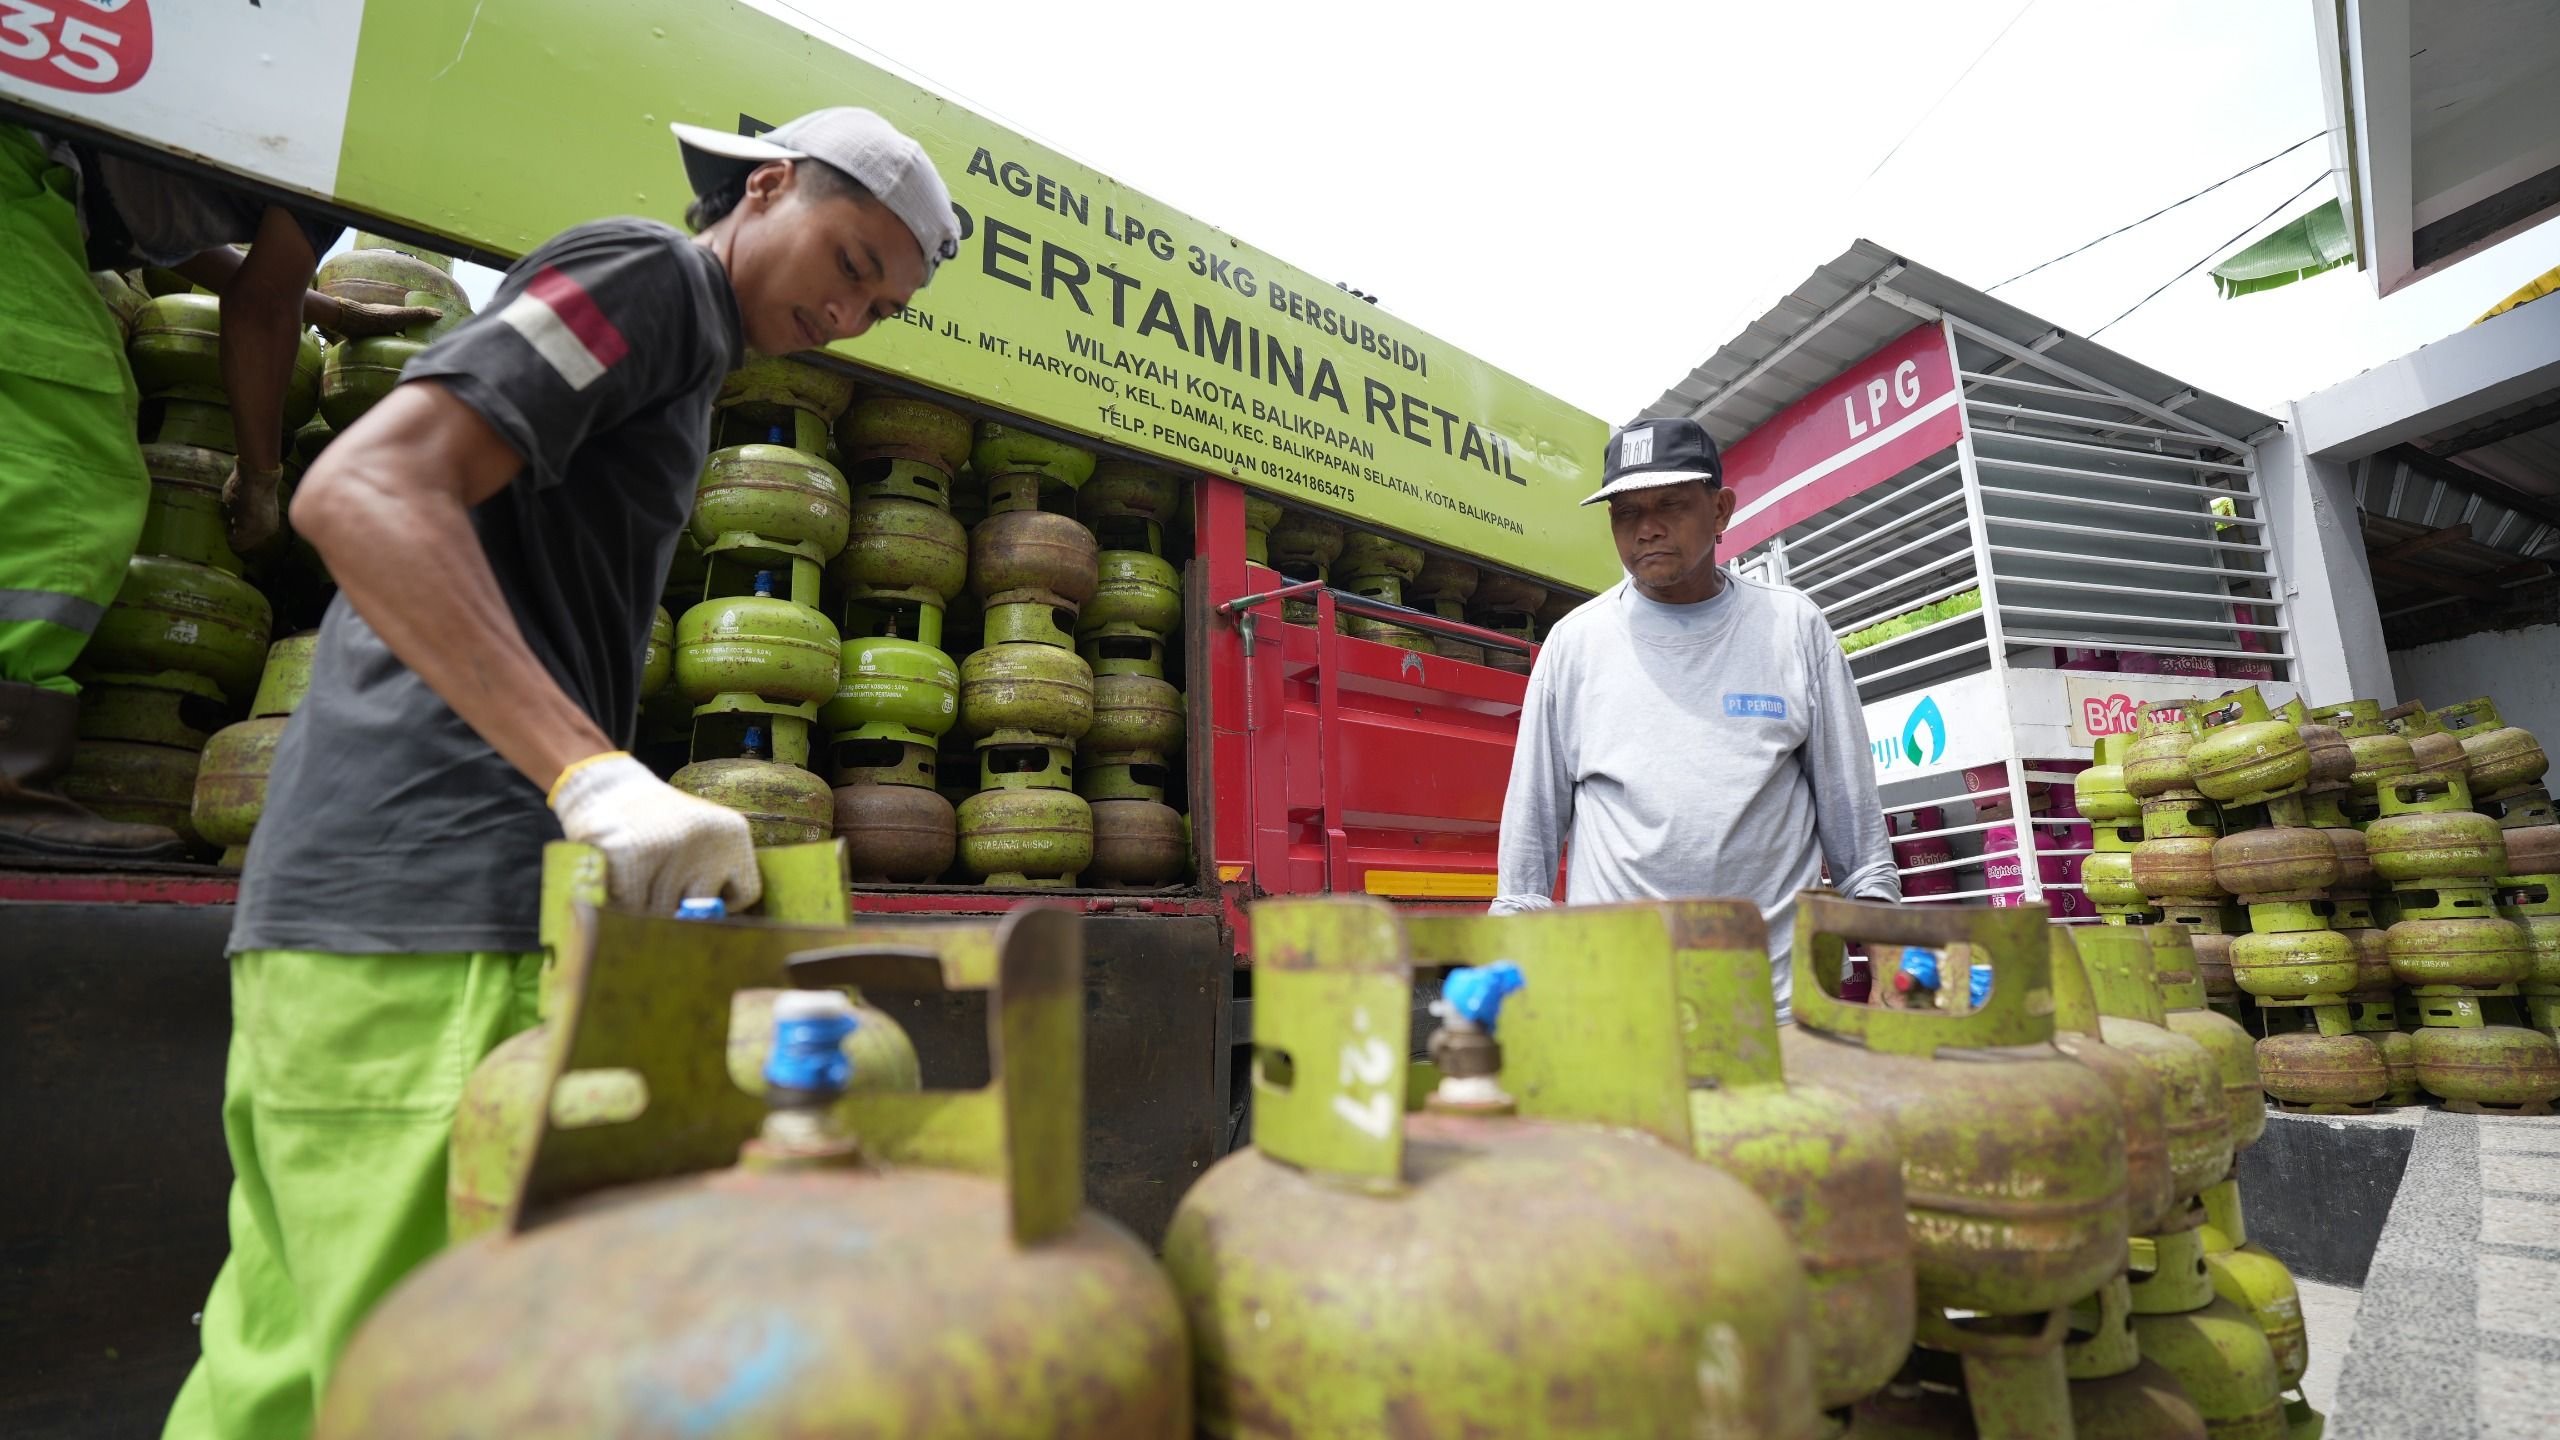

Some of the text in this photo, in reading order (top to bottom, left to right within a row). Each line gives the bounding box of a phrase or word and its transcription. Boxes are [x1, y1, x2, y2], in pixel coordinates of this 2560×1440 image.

[966, 147, 1427, 377] AGEN LPG 3KG BERSUBSIDI
[889, 306, 1524, 536] EN JL. MT. HARYONO, KEL. DAMAI, KEC. BALIKPAPAN SELATAN, KOTA BALIKPAPAN
[1066, 330, 1374, 460] WILAYAH KOTA BALIKPAPAN
[1364, 376, 1527, 487] RETAIL
[1845, 359, 1921, 440] LPG
[1098, 406, 1355, 502] TELP. PENGADUAN 081241865475
[1729, 699, 1745, 711] PT.
